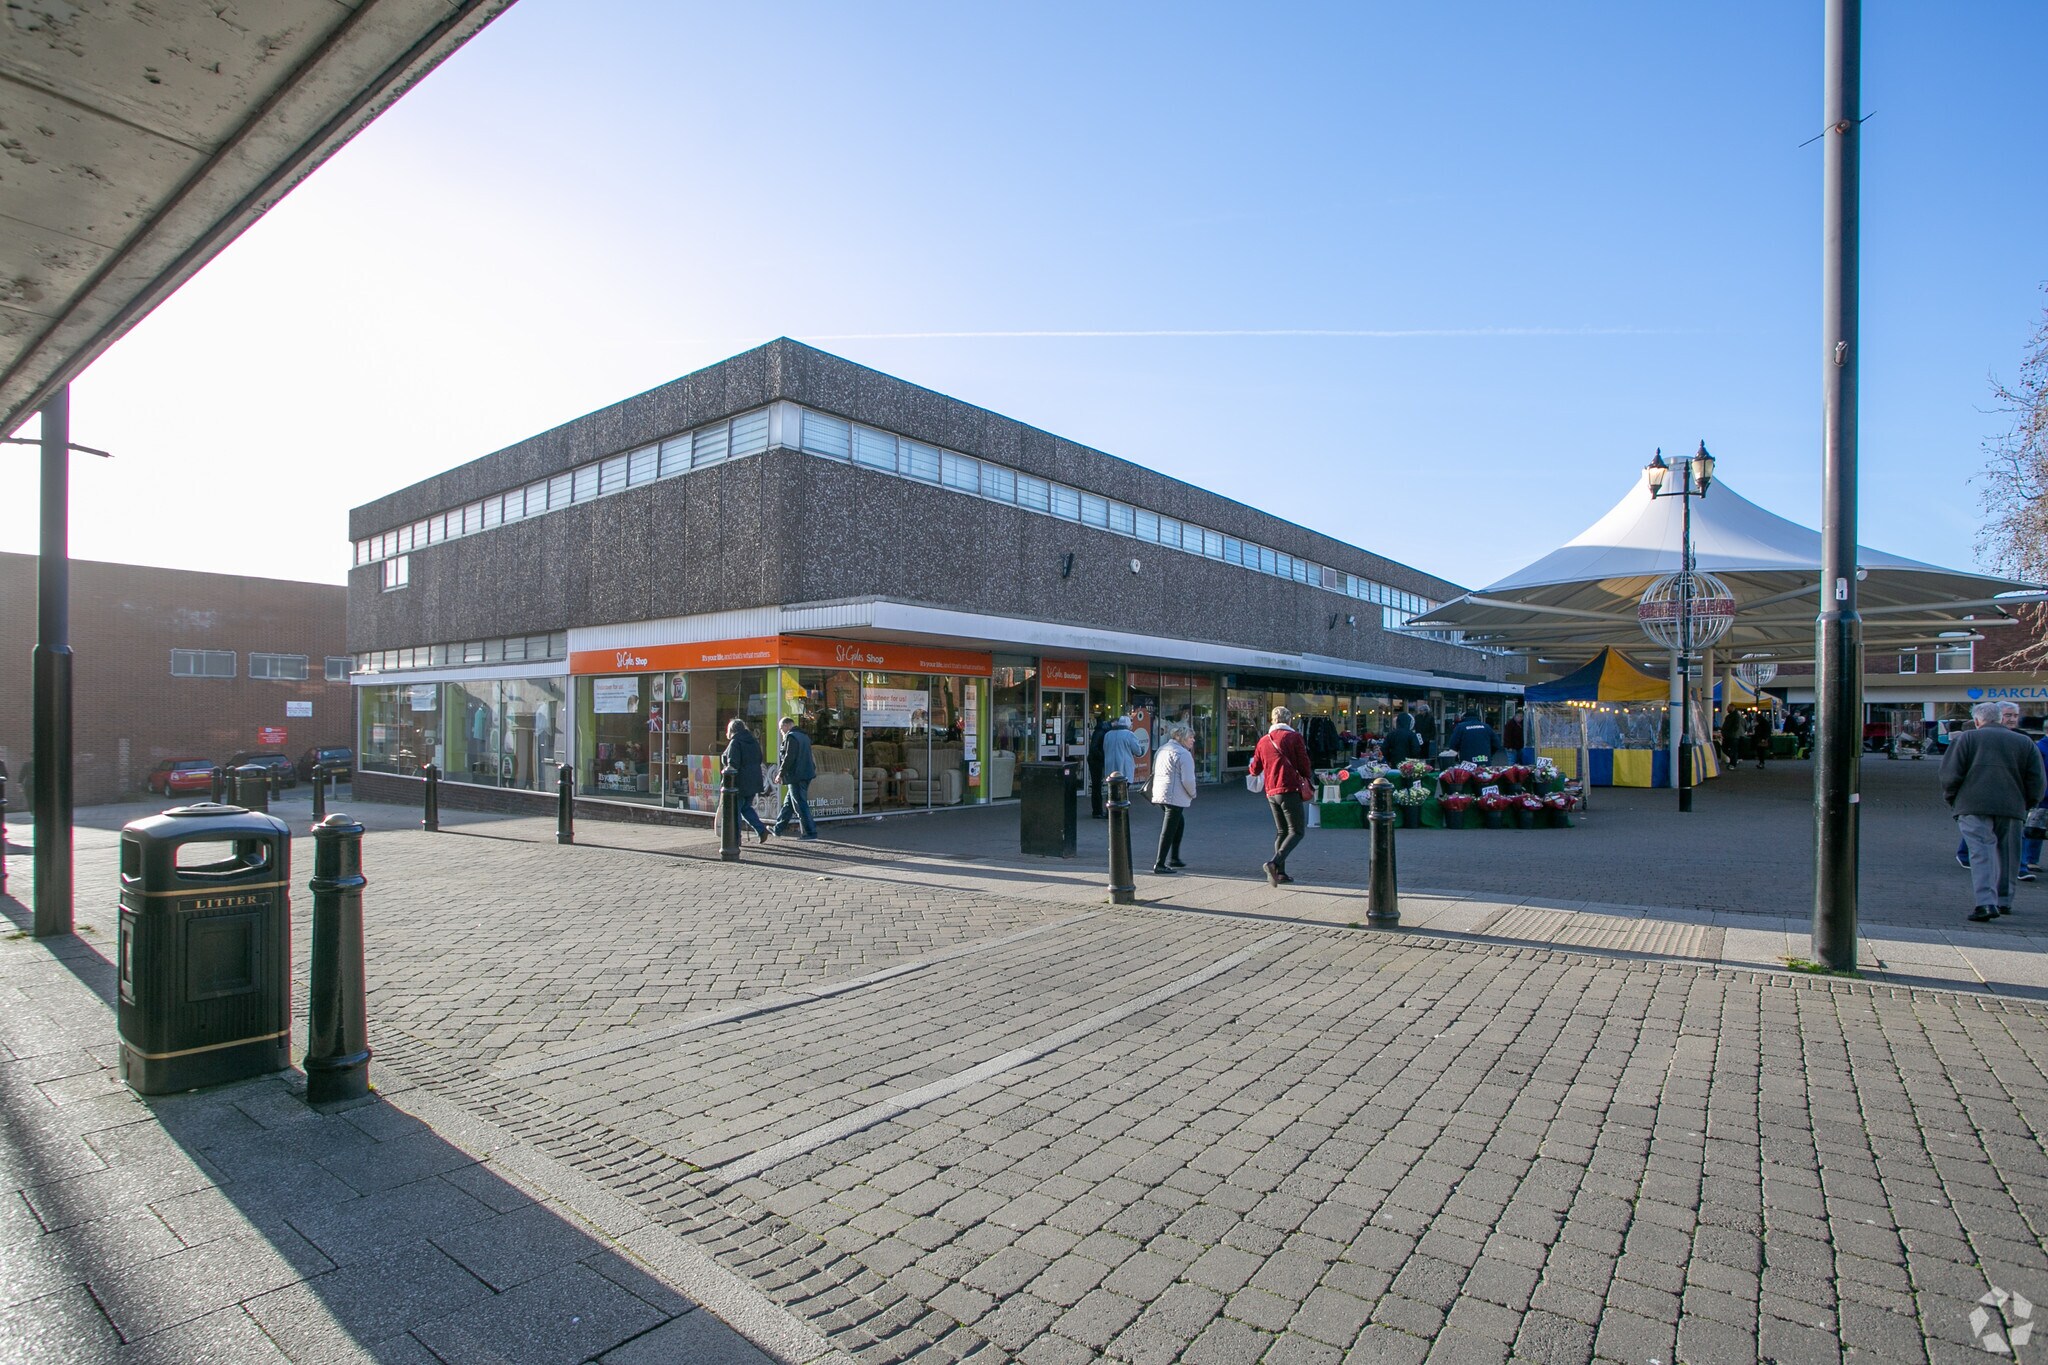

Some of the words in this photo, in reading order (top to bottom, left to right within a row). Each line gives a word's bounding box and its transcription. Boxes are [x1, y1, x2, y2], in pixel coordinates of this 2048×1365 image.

[1839, 590, 1844, 599] 1
[836, 644, 845, 662] St
[866, 653, 884, 664] Shop
[635, 657, 648, 667] Shop
[1063, 671, 1082, 680] Boutique
[1297, 680, 1348, 695] MARKET
[890, 694, 899, 702] for
[807, 799, 816, 807] ur
[829, 796, 844, 806] and
[195, 895, 257, 909] LITTER
